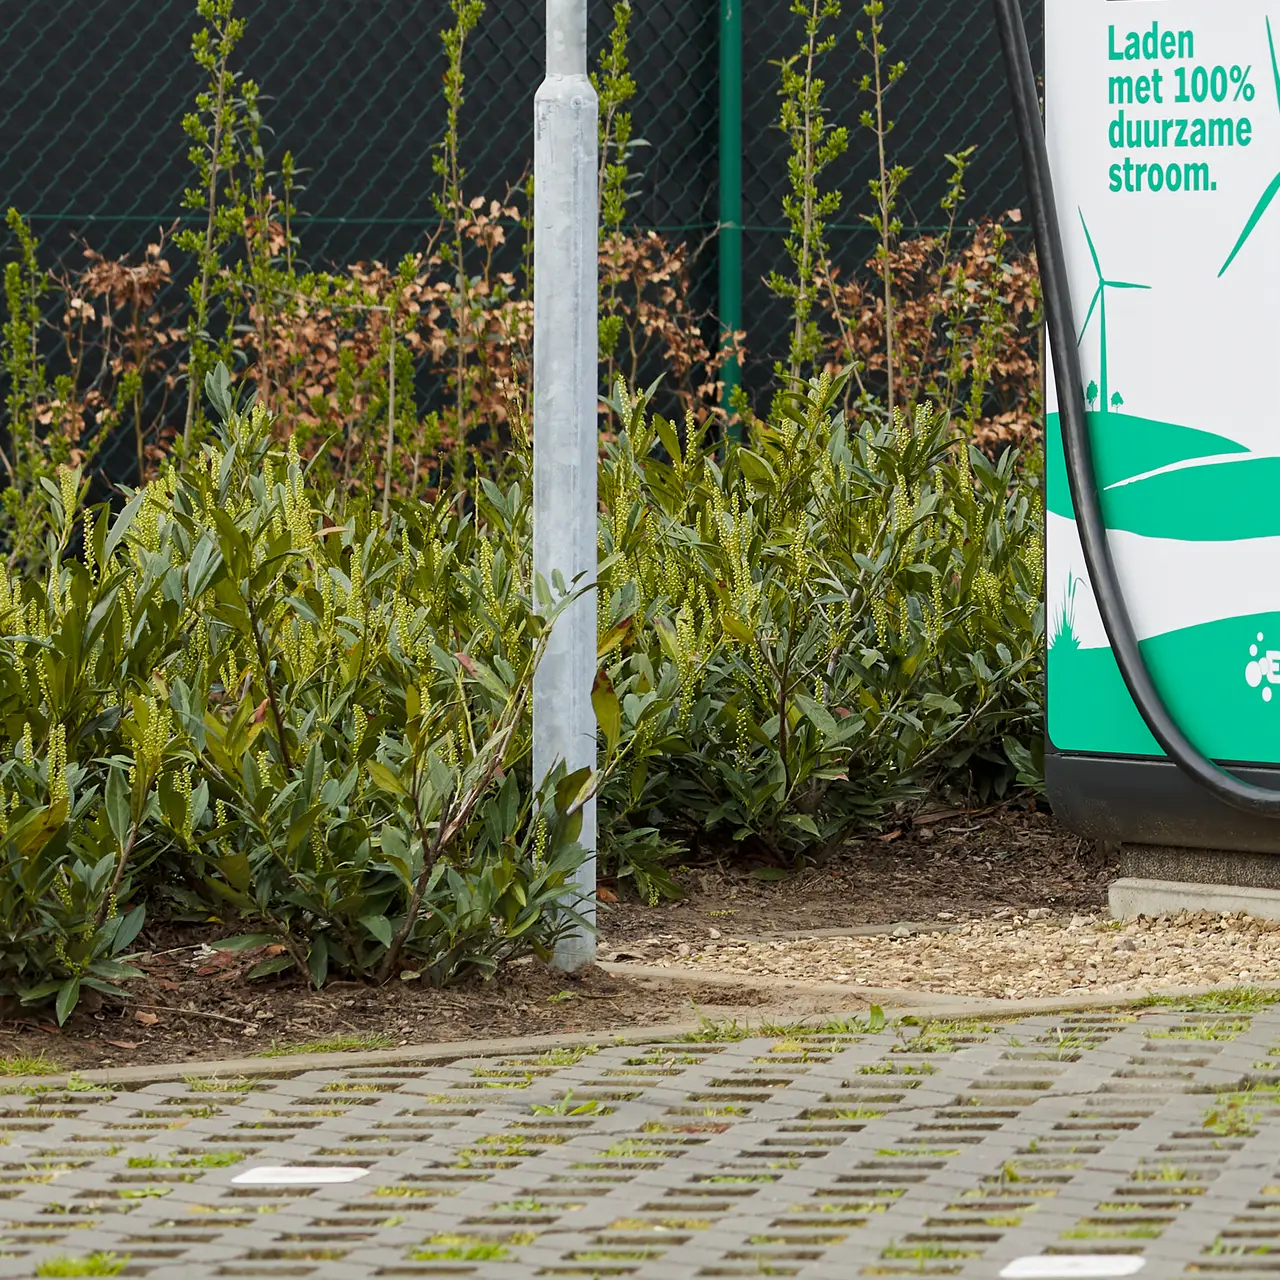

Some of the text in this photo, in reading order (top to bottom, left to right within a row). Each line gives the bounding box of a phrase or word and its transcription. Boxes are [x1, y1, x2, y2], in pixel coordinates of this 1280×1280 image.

[1108, 21, 1194, 60] Laden
[1108, 65, 1255, 104] met 100%
[1108, 109, 1252, 148] duurzame
[1108, 157, 1217, 192] stroom.
